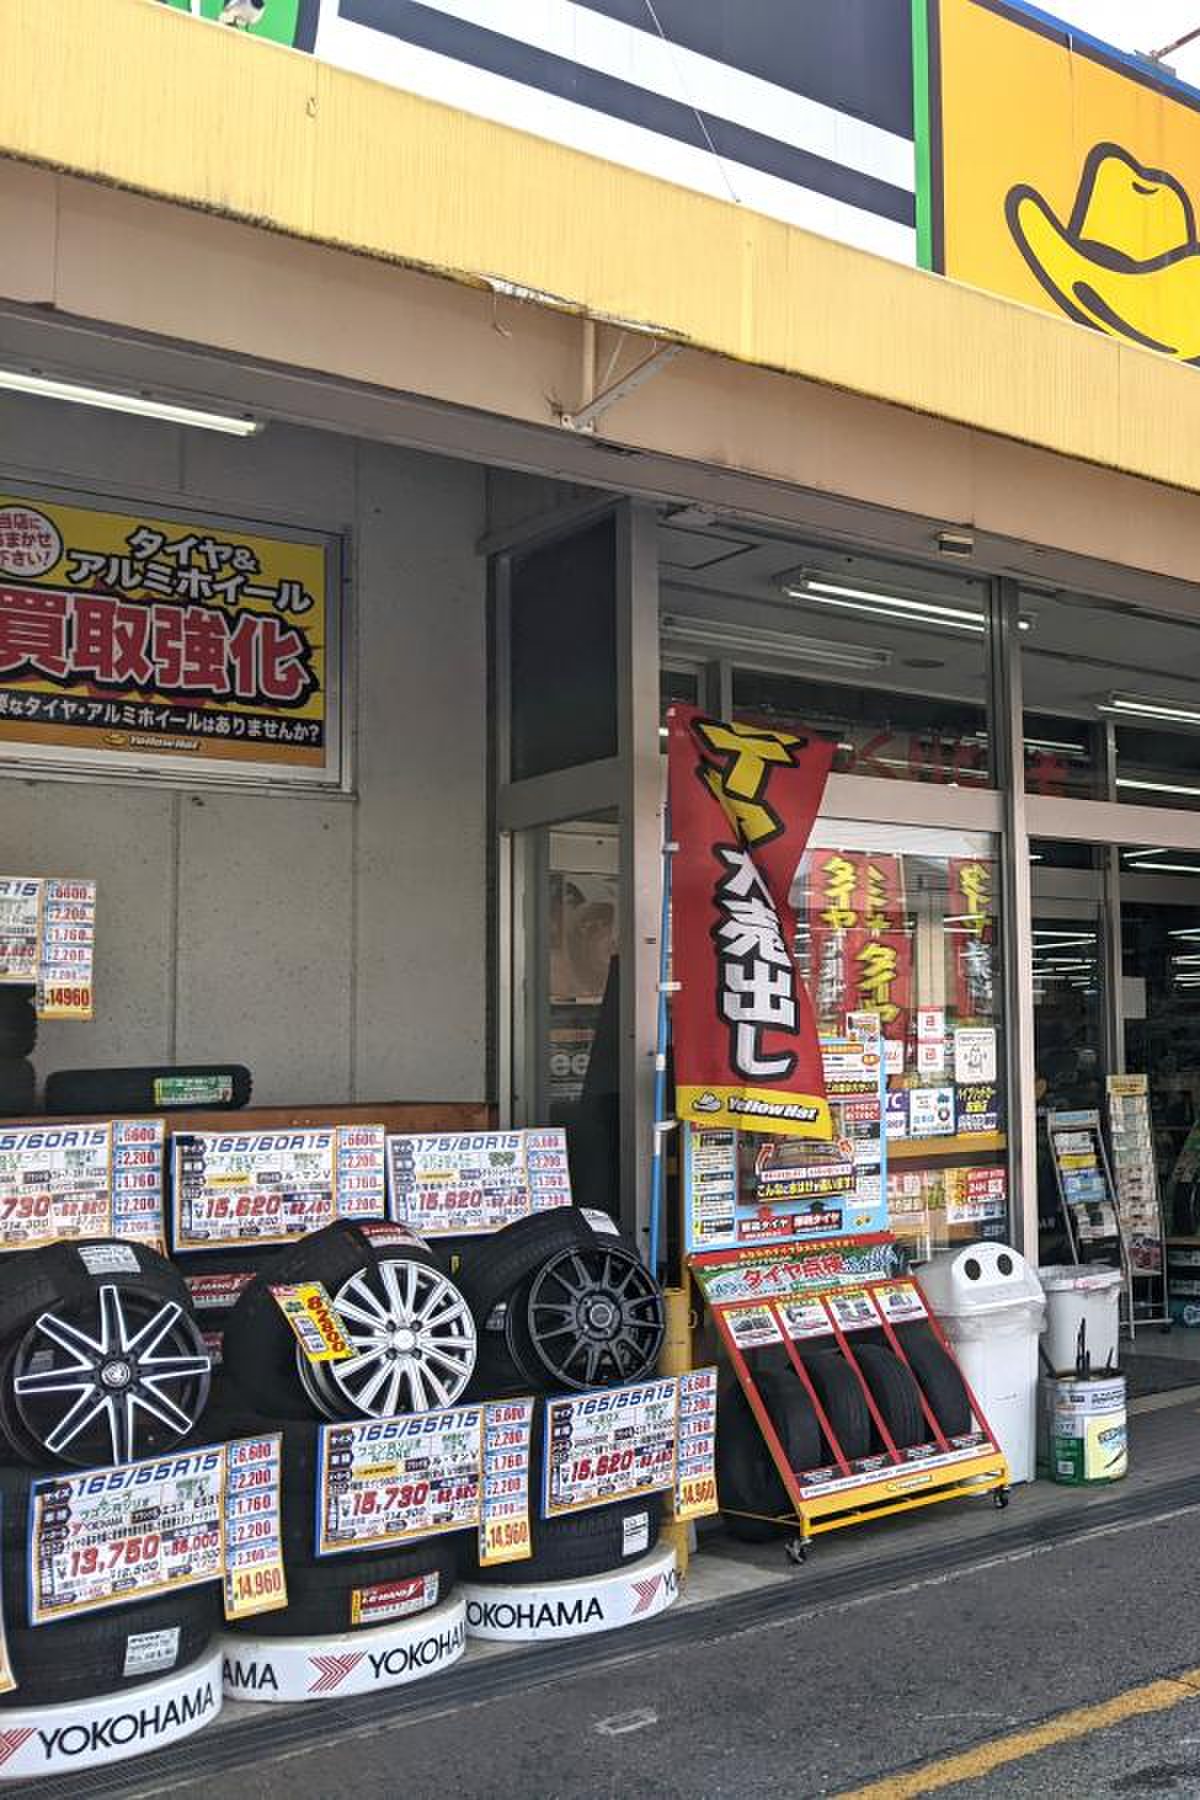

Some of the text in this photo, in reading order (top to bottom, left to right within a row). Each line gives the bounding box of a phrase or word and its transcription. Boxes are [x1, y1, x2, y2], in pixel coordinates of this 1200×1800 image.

[131, 527, 257, 573] タイヤ&
[67, 549, 313, 613] アルミホイール
[0, 589, 309, 699] 買取強化
[727, 1097, 818, 1122] YellowHat
[211, 1133, 330, 1153] 165/60R15
[577, 1383, 675, 1416] 165/55R15
[359, 1411, 479, 1442] 165/55R15
[78, 1453, 219, 1497] 165/55R15
[38, 1682, 215, 1760] YOKOHAMA
